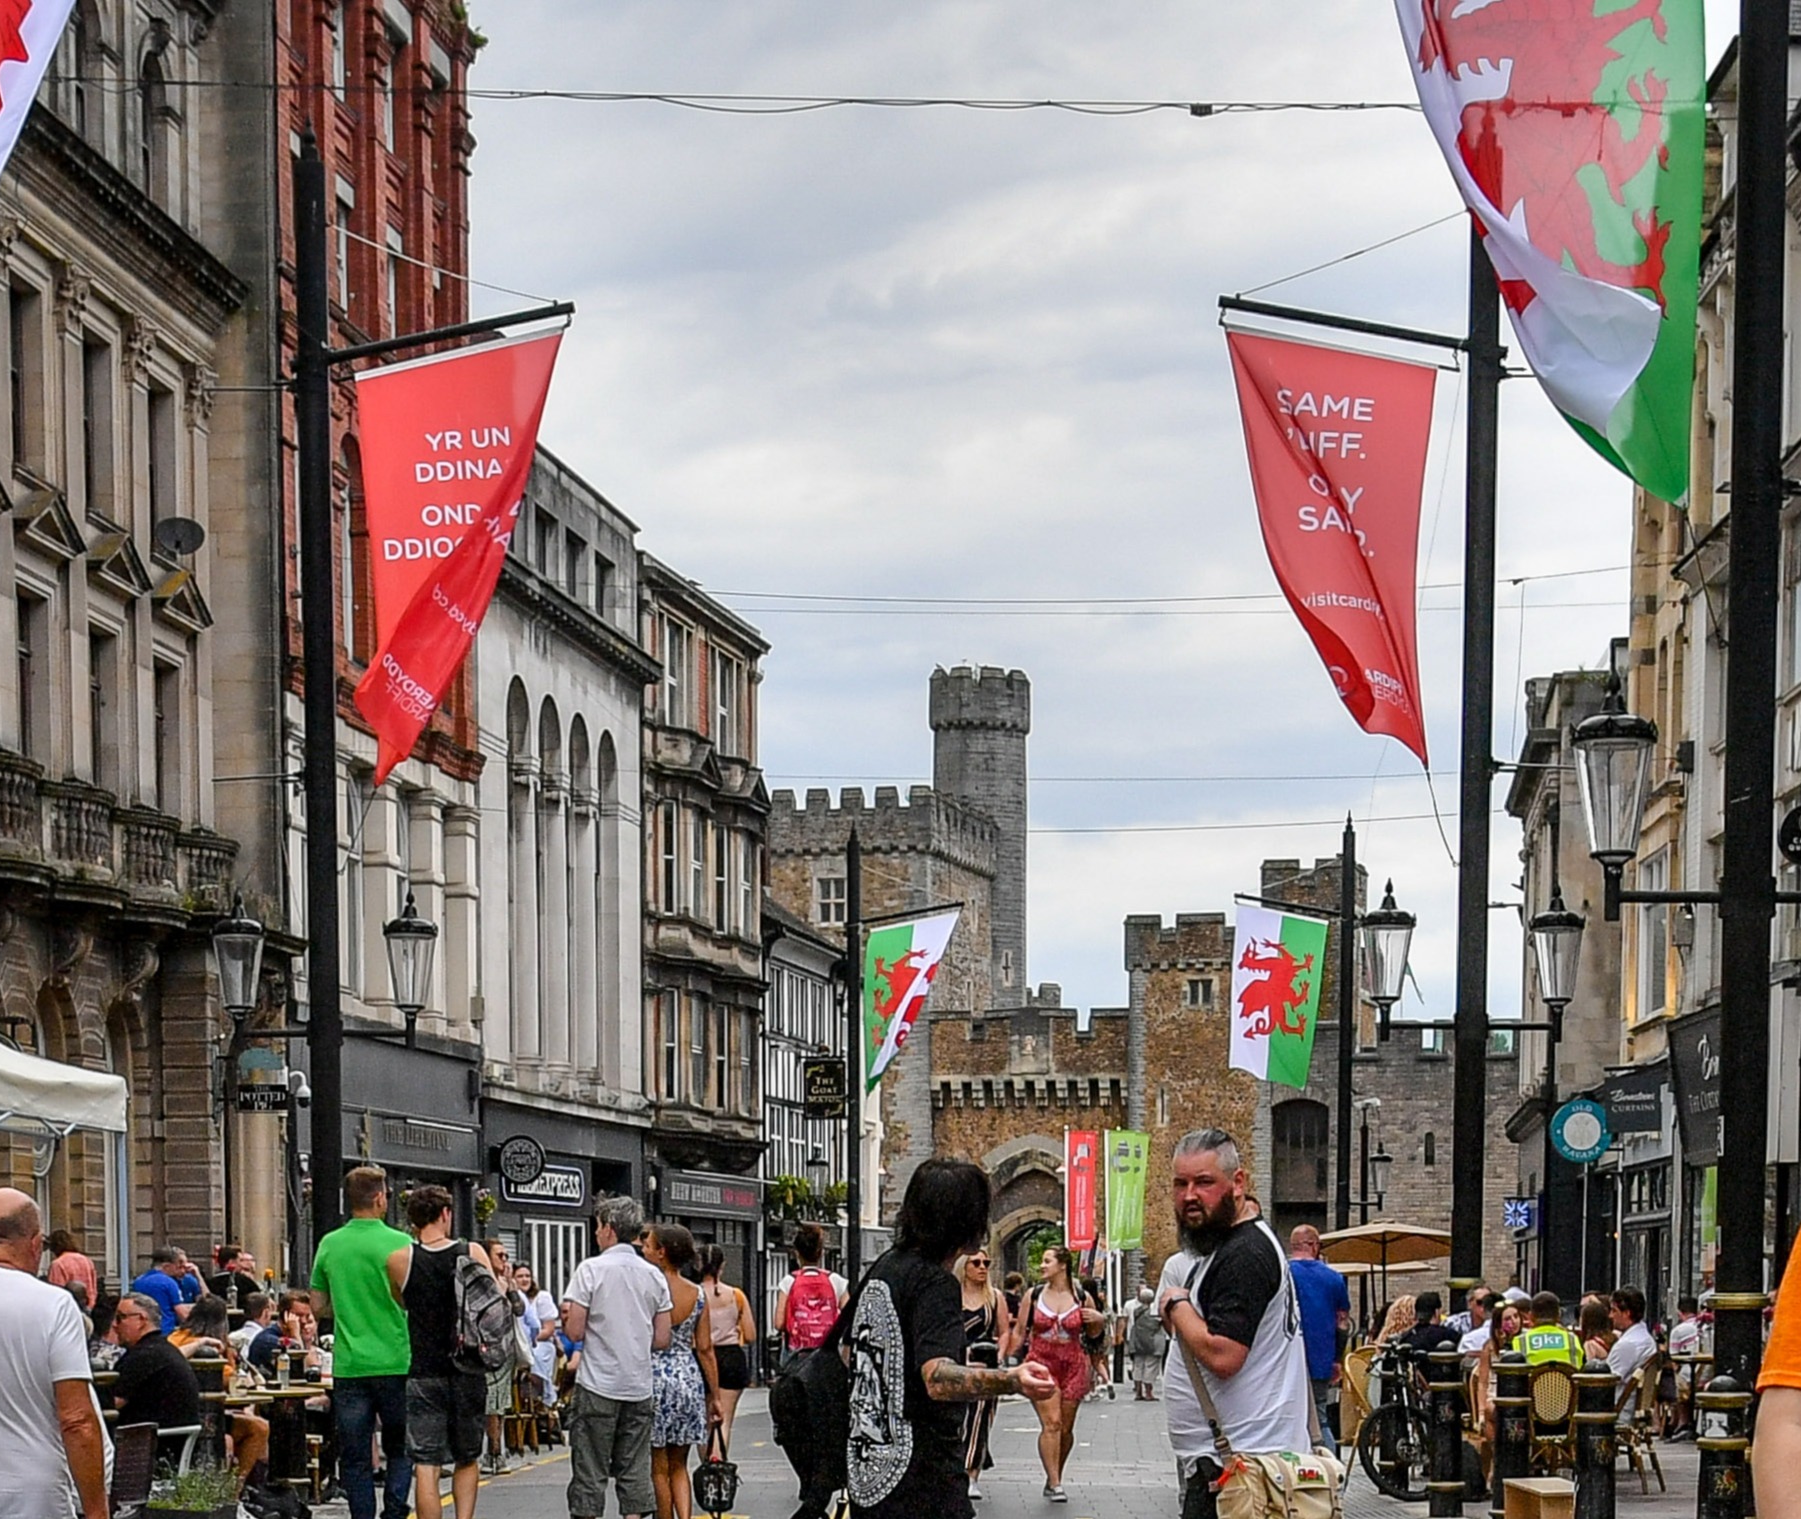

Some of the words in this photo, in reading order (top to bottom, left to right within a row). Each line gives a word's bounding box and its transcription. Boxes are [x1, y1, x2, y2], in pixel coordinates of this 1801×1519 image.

[1277, 389, 1375, 421] SAME
[425, 431, 462, 451] YR
[471, 426, 511, 447] UN
[415, 458, 509, 483] DDINA
[1610, 1103, 1656, 1114] CURTAINS
[1531, 1334, 1562, 1349] gkr
